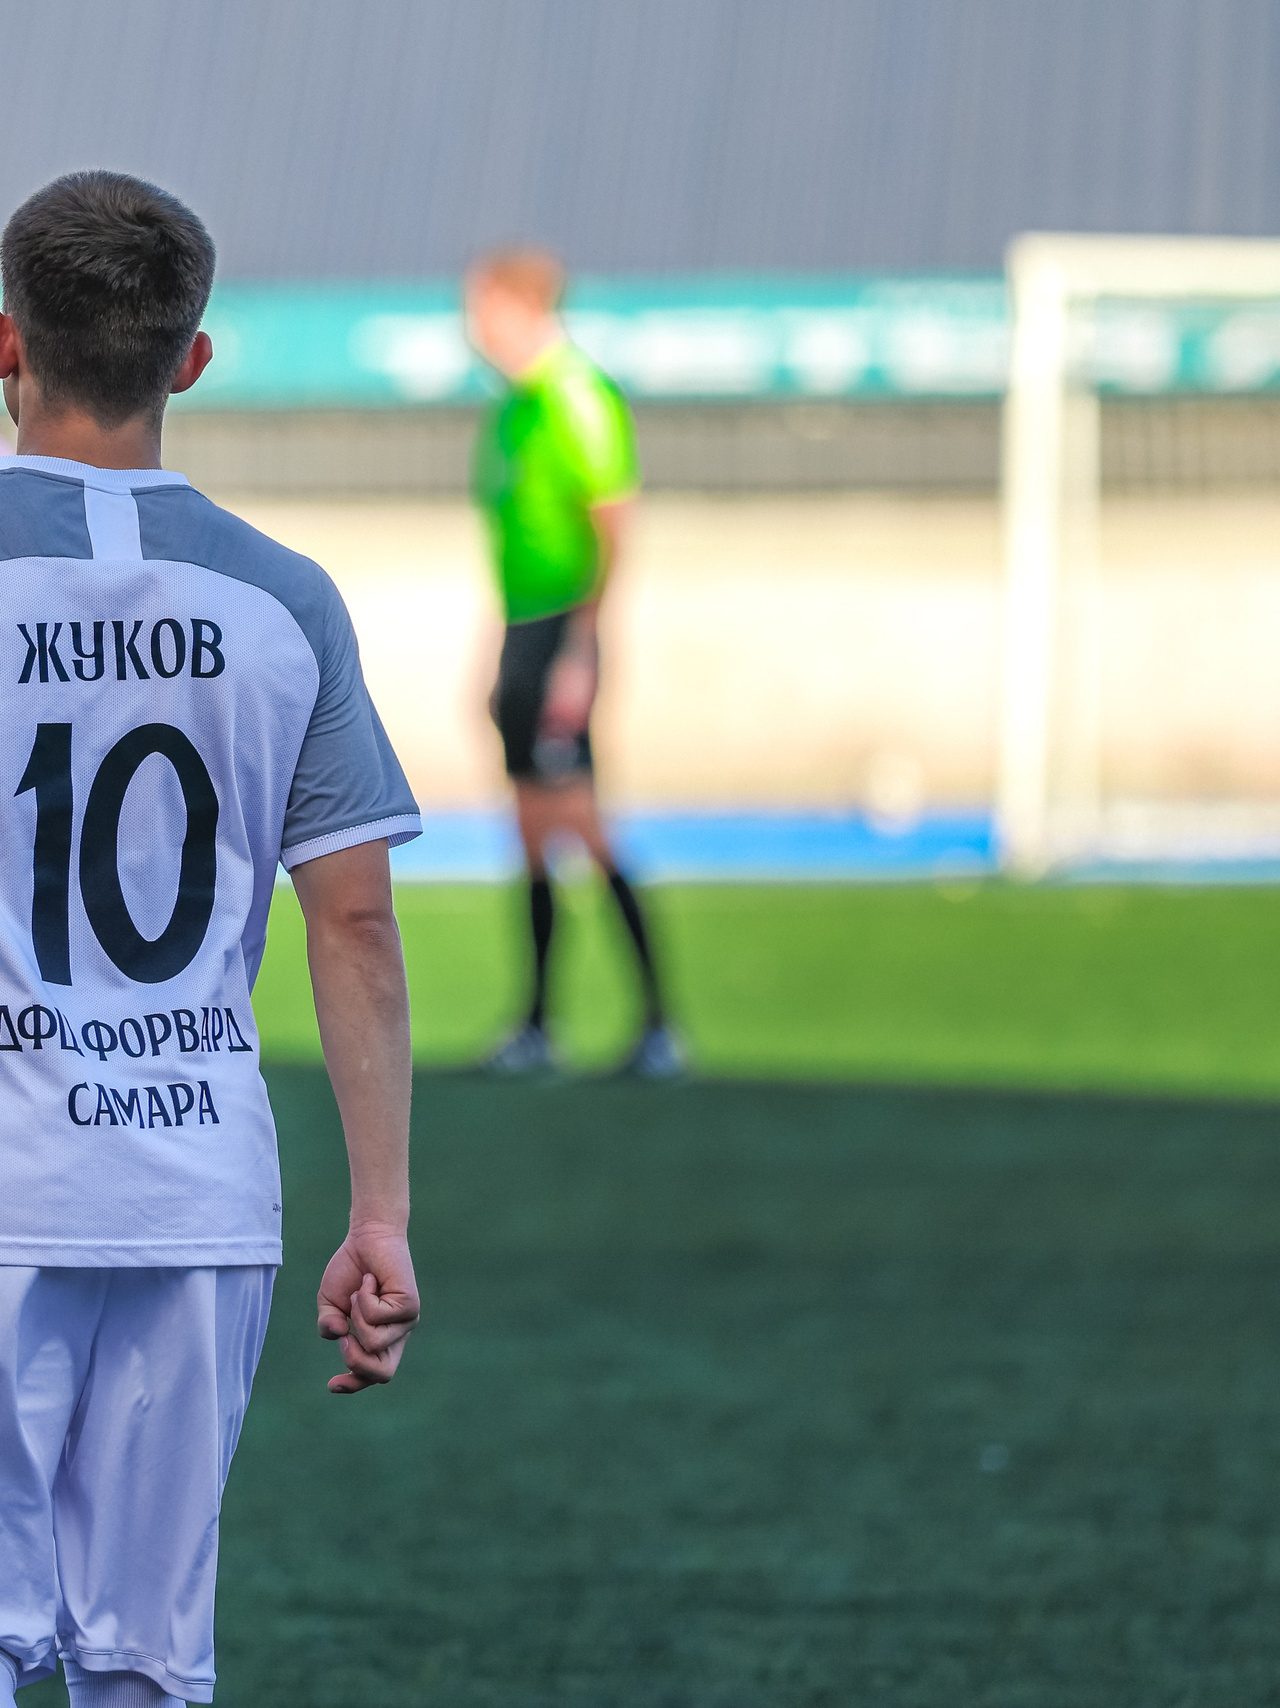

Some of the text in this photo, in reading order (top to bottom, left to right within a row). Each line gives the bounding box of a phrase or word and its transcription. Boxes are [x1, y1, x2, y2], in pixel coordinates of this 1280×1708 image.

[17, 619, 226, 684] ЖУКОВ
[14, 723, 219, 986] 10
[81, 1007, 254, 1062] ФОРВАРД
[68, 1081, 220, 1129] САМАРА
